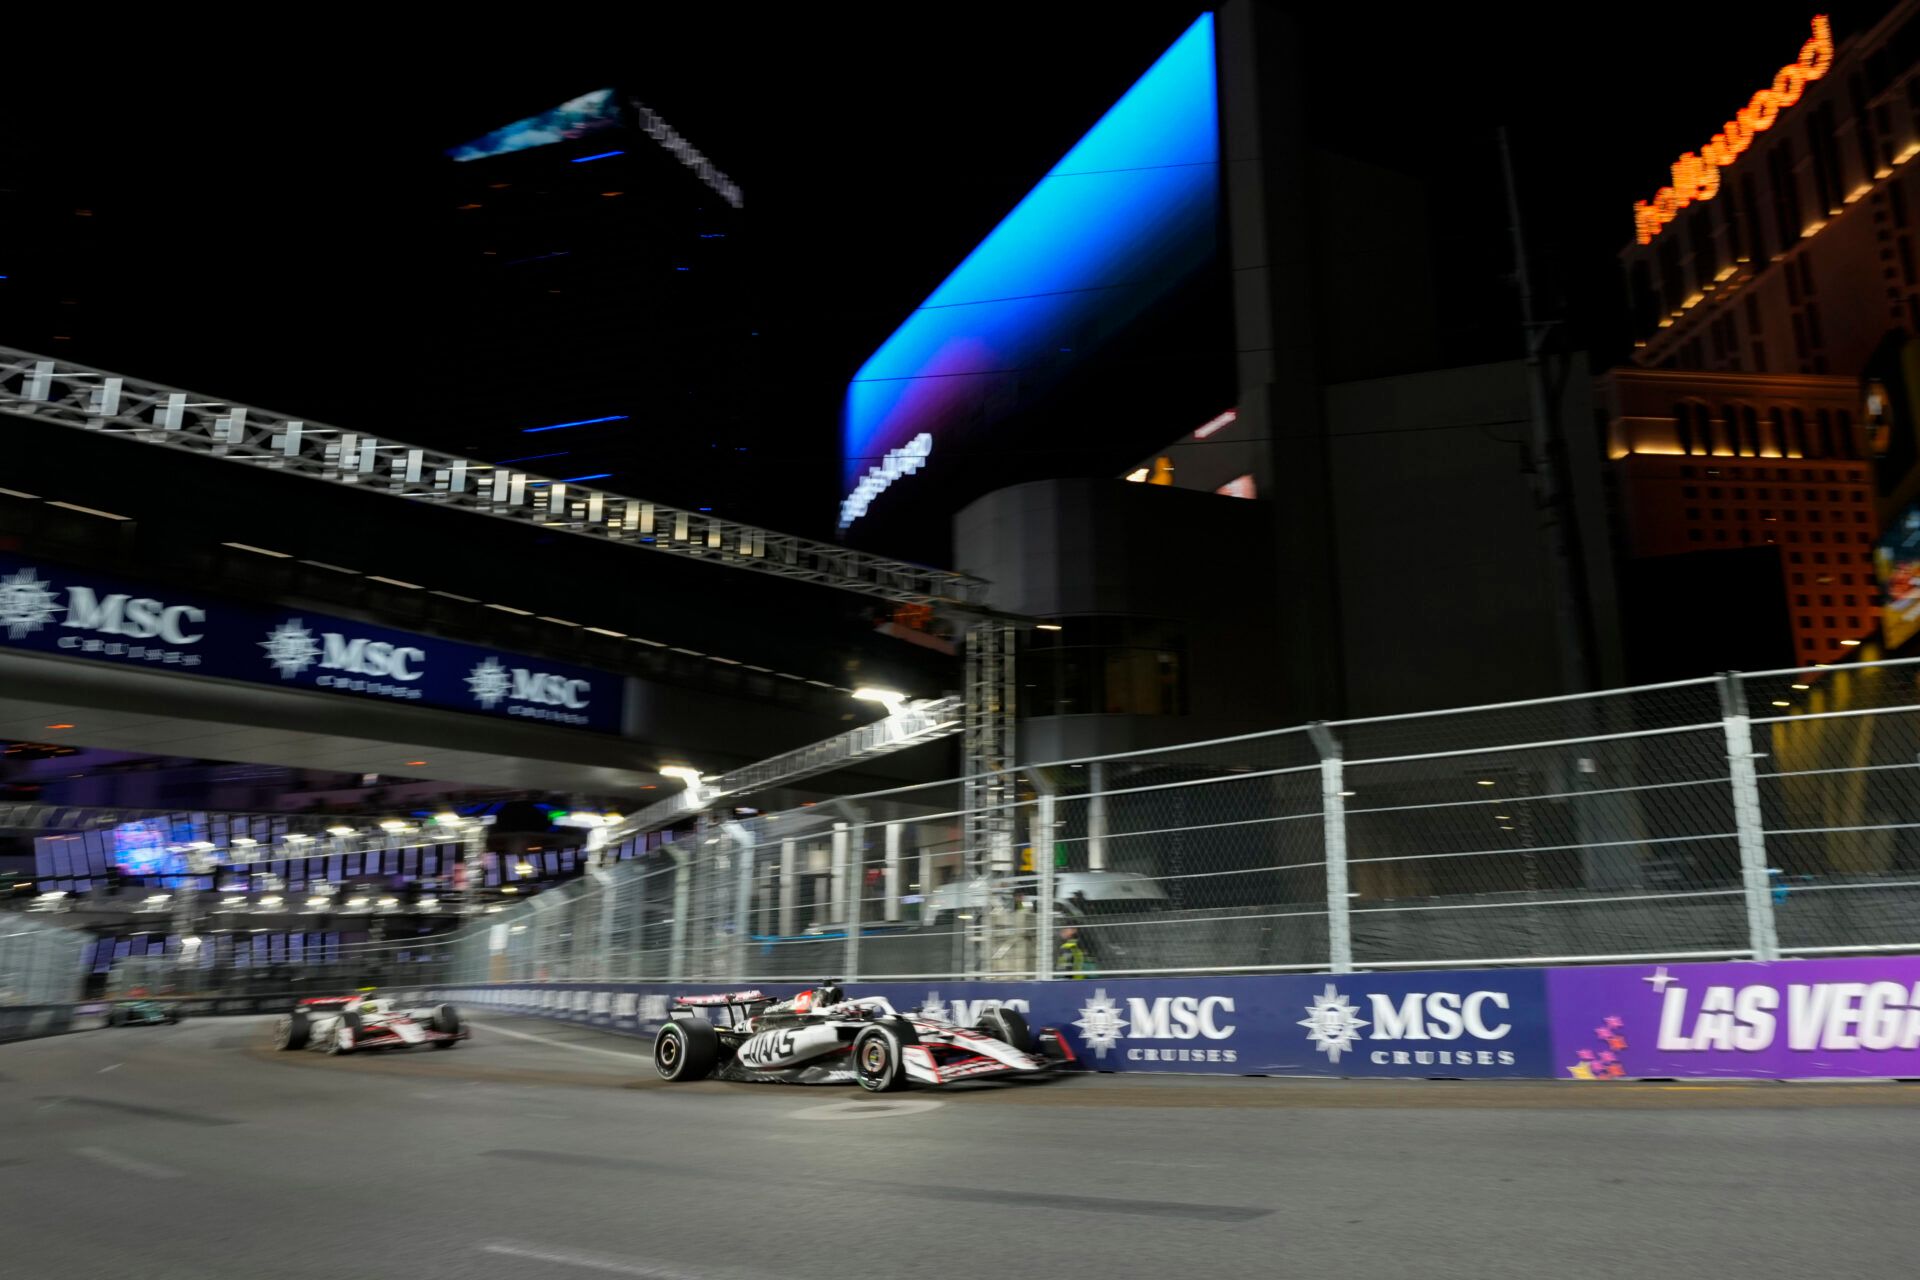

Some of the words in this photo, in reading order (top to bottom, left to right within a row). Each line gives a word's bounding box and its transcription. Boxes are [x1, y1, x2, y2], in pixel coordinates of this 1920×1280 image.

[60, 586, 206, 644] MSC
[317, 632, 426, 681] MSC
[508, 668, 591, 709] MSC
[1127, 996, 1236, 1041] MSC
[1369, 991, 1512, 1041] MSC
[1656, 984, 1780, 1051] LAS
[1126, 1049, 1238, 1063] CRUISES
[1370, 1050, 1516, 1066] CRUISES
